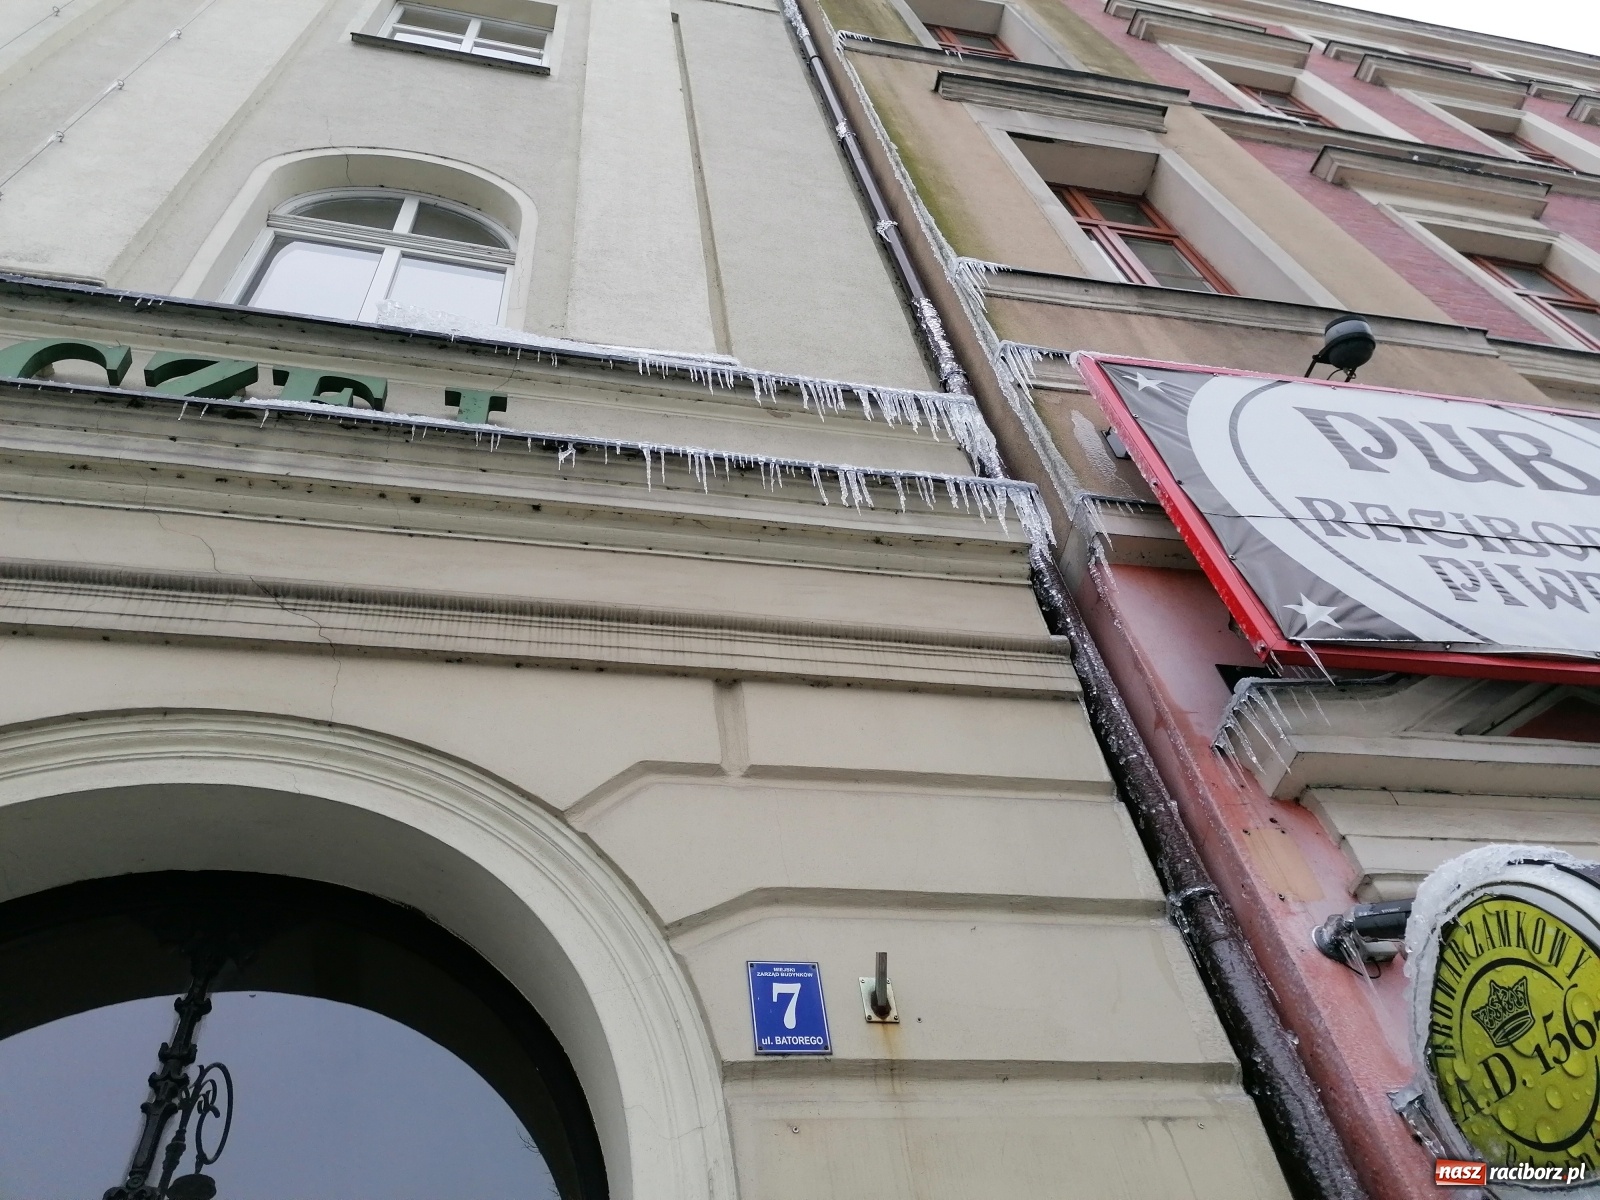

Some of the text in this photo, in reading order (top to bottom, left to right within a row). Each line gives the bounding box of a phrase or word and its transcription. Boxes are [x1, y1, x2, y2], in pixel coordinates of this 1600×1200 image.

[1292, 406, 1600, 496] PUB
[772, 982, 801, 1029] 7
[1431, 909, 1592, 1058] BROWAR ZAMKOWY
[761, 1036, 823, 1045] ul. BATOREGO
[1532, 983, 1600, 1076] 156
